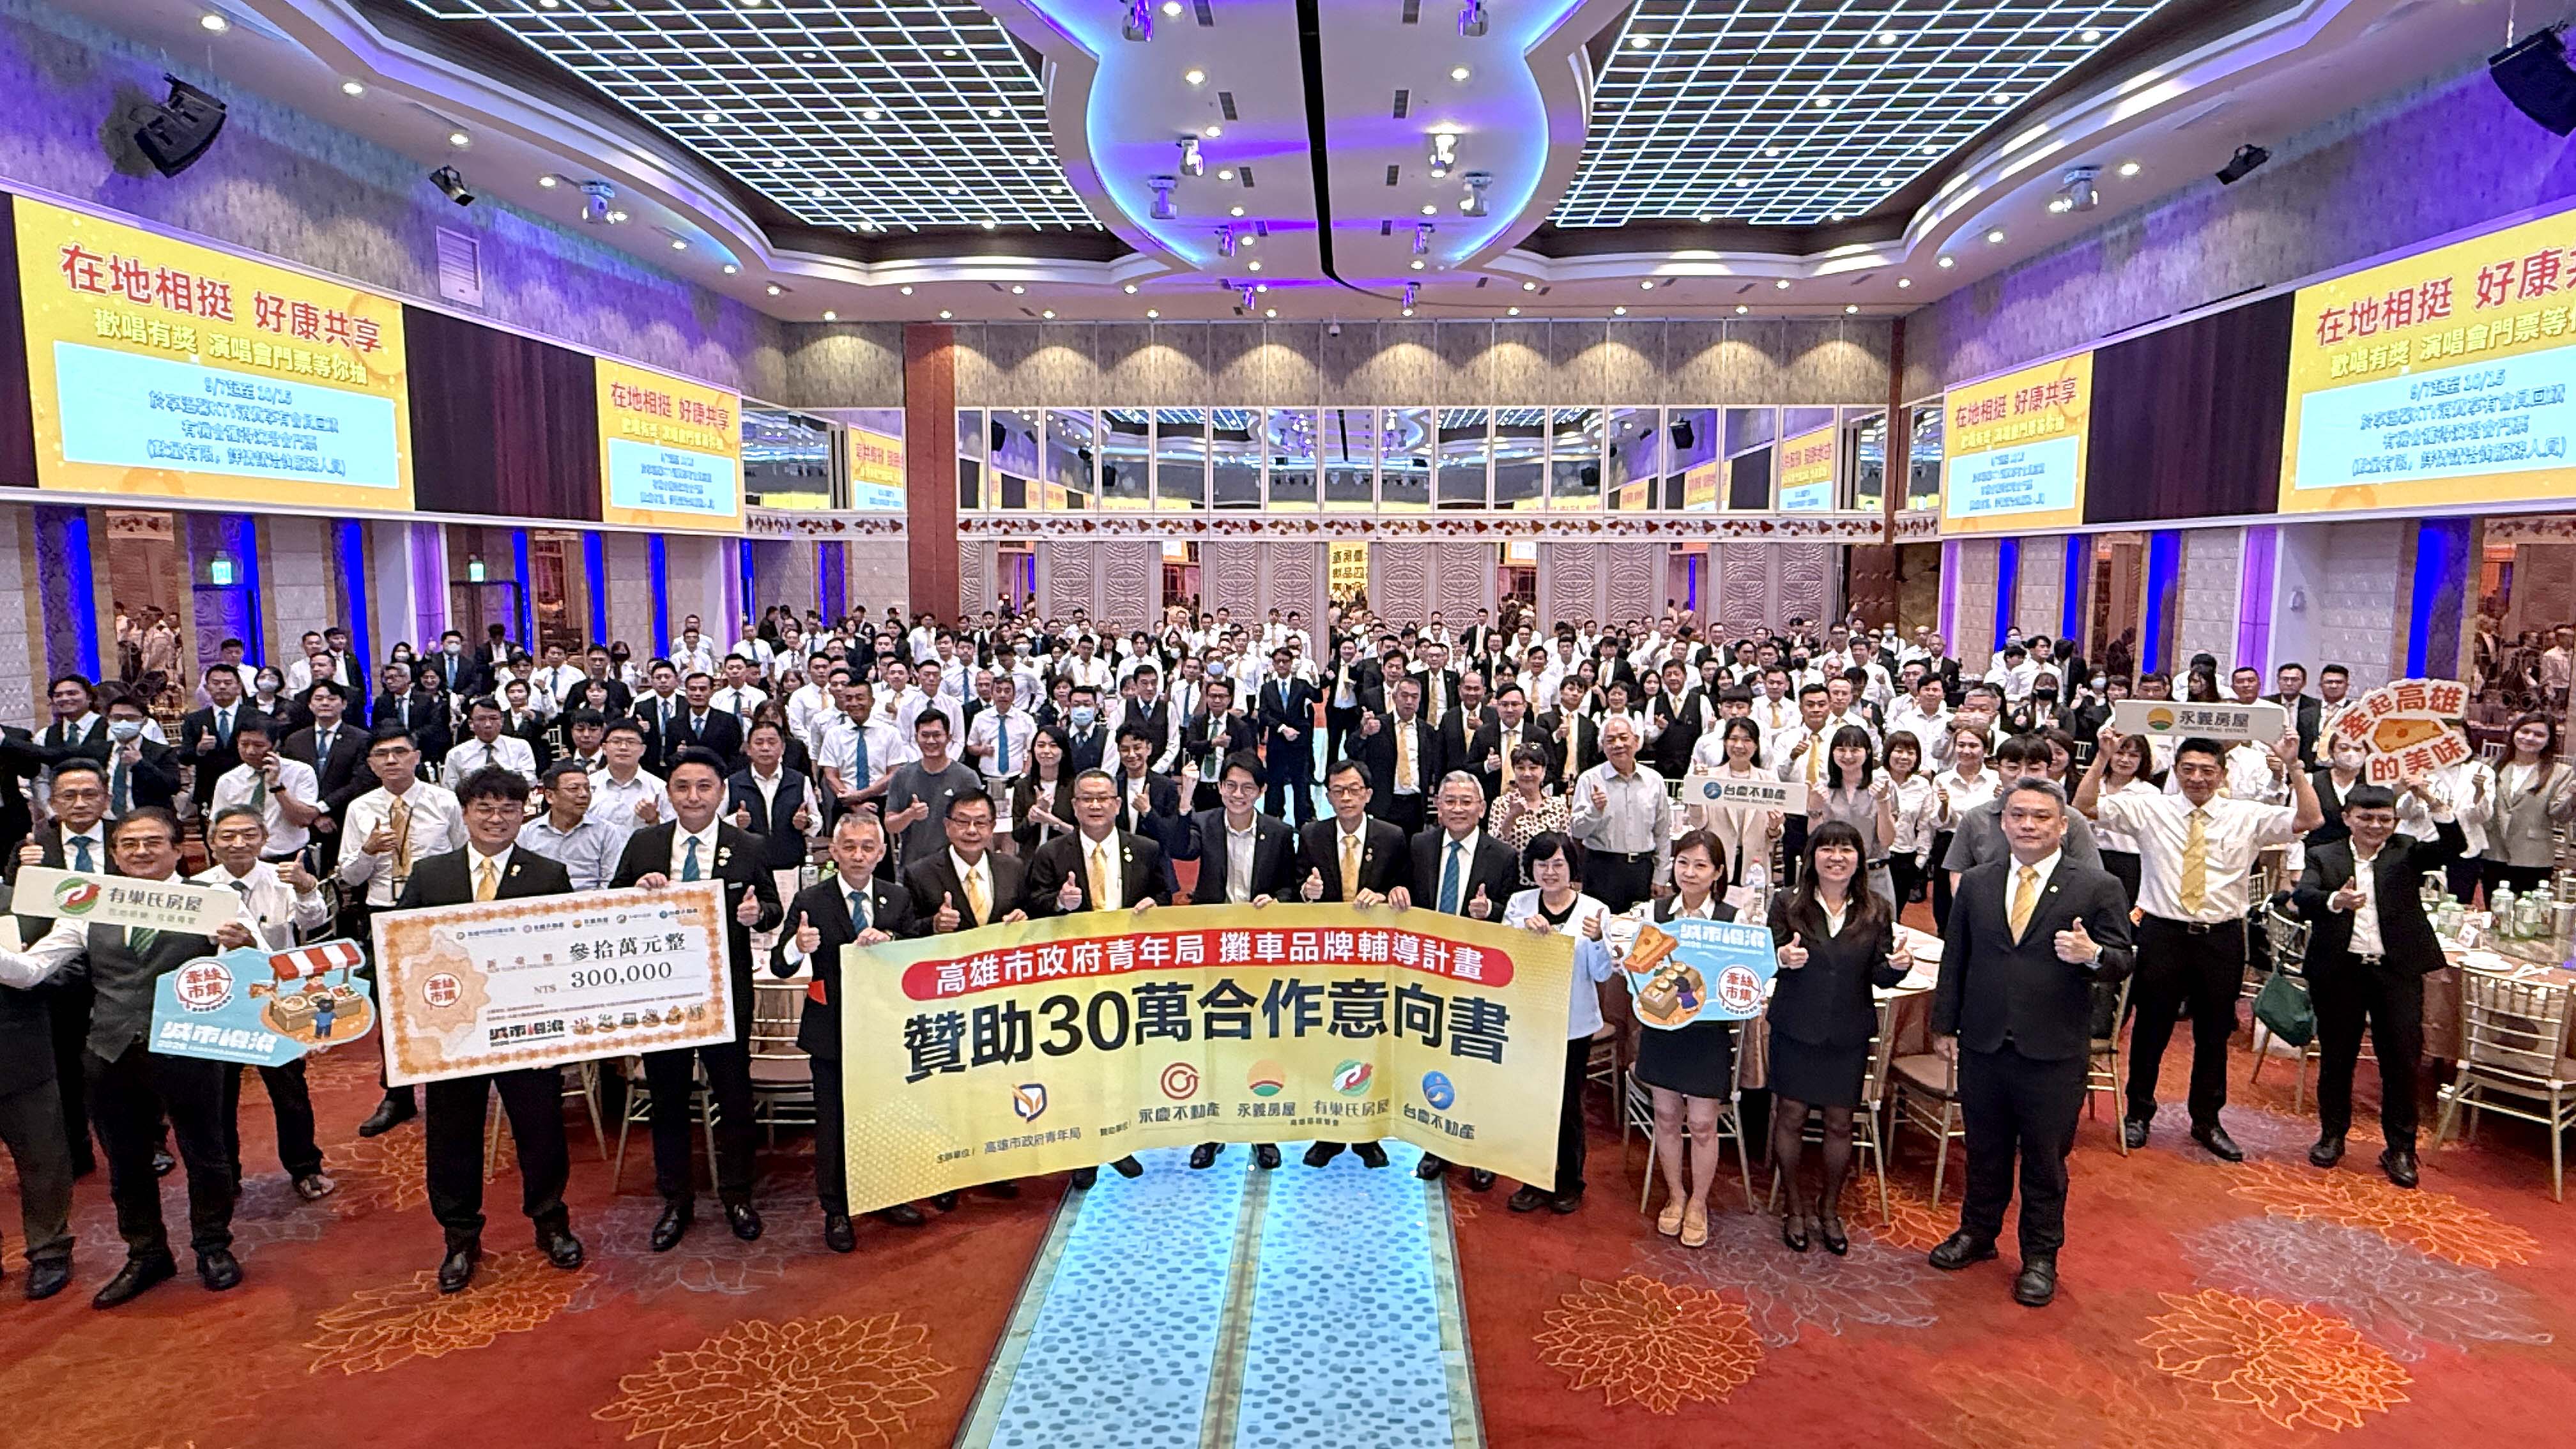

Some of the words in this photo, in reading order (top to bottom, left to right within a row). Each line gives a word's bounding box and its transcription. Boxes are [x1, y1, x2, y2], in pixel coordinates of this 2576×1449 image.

[59, 243, 234, 323] 在地相挺
[253, 290, 381, 353] 好康共享
[2317, 276, 2453, 346] 在地相挺
[93, 307, 198, 355] 歡唱有獎
[208, 332, 368, 385] 演唱會門票等你抽
[2330, 338, 2411, 379] 歡唱有獎
[2419, 302, 2576, 361] 演唱會門票等
[611, 381, 671, 418] 在地相挺
[679, 397, 730, 430] 好康共享
[1956, 394, 2007, 429] 在地相挺
[2014, 377, 2076, 415] 好康共享
[2179, 710, 2249, 727] 永義房屋
[2335, 684, 2464, 741] 牽起高雄
[2372, 736, 2465, 781] 的美味
[1724, 783, 1786, 800] 台慶不動產
[109, 887, 203, 912] 有巢氏房屋
[569, 931, 686, 962] 參拾萬元整
[936, 933, 1205, 996] 高雄市政府青年局
[1219, 931, 1483, 981] 攤車品牌輔導計畫
[571, 962, 672, 988] 300,000
[904, 977, 1510, 1084] 贊助30萬合作意向書
[1139, 1101, 1220, 1124] 永慶不動產
[1237, 1102, 1296, 1117] 永義房屋
[1314, 1098, 1390, 1117] 有巢氏房屋
[1404, 1103, 1475, 1140] 台慶不動產
[985, 1127, 1081, 1154] 高雄市政府青年局
